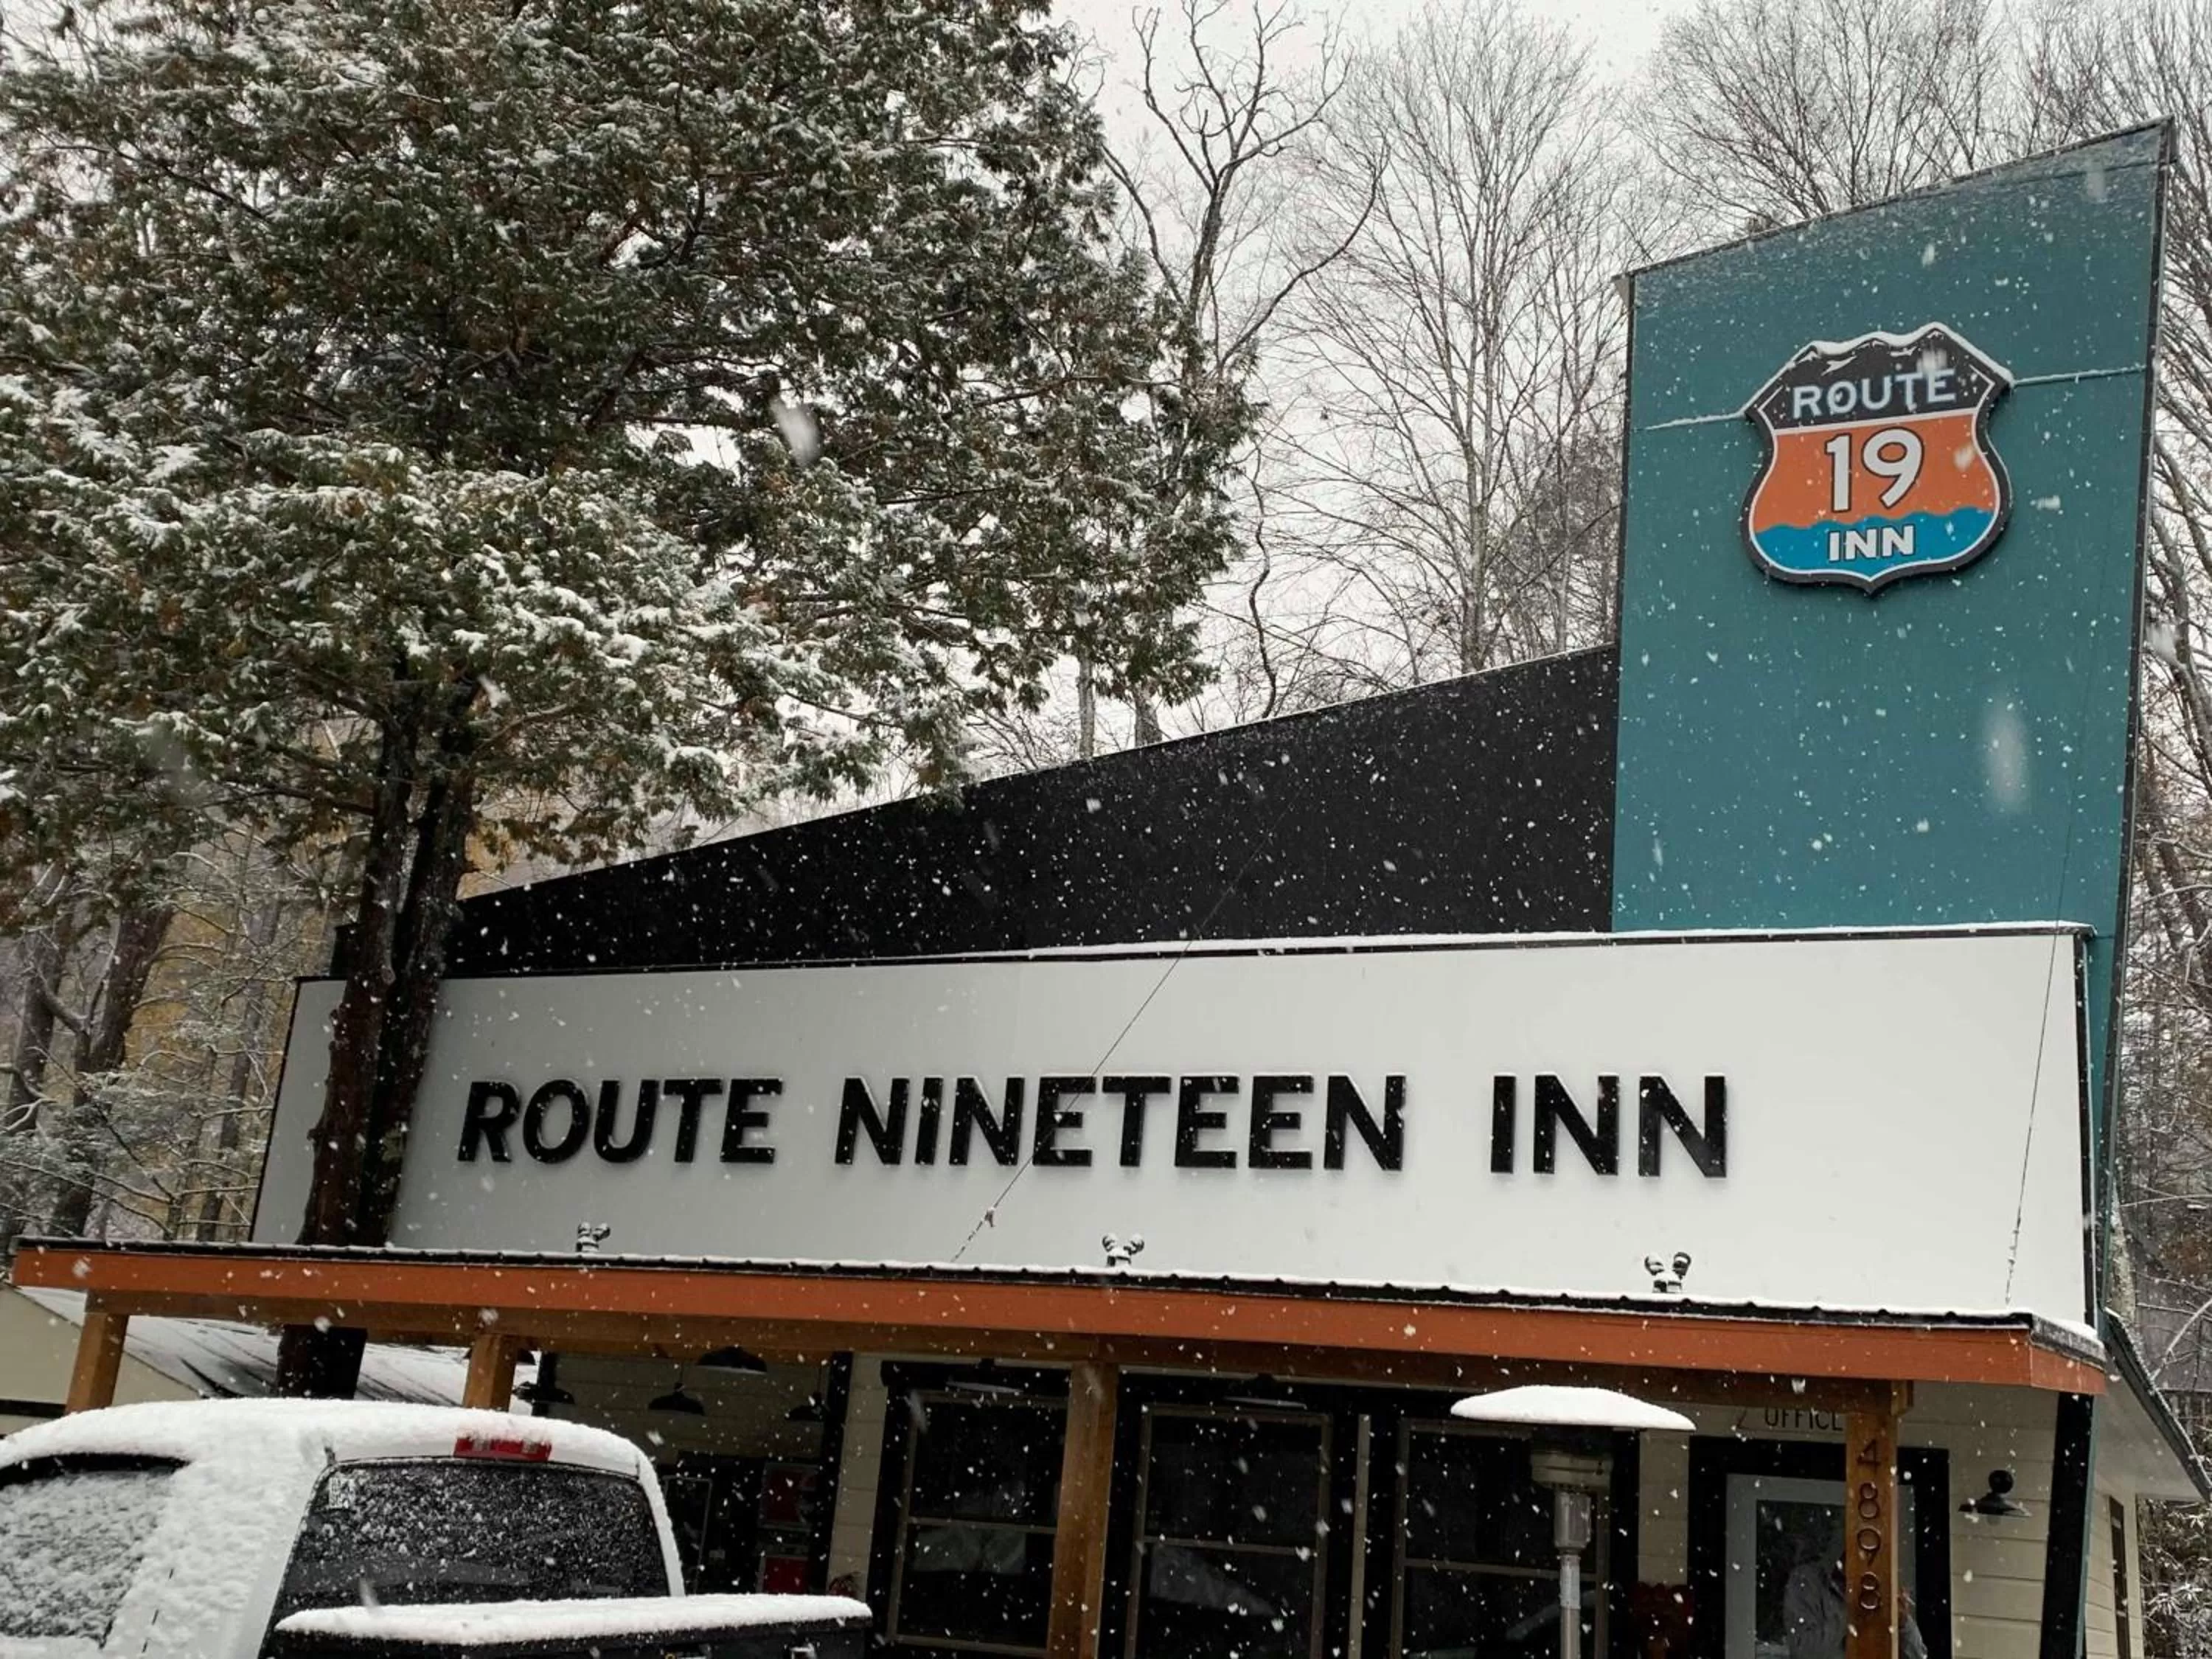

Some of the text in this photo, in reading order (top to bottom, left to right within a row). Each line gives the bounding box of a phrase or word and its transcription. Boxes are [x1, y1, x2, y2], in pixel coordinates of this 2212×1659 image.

[1792, 369, 1956, 419] ROUTE
[1825, 426, 1924, 514] 19
[1828, 524, 1915, 562] INN
[457, 1074, 1726, 1178] ROUTE NINETEEN INN
[1857, 1439, 1881, 1610] 4898
